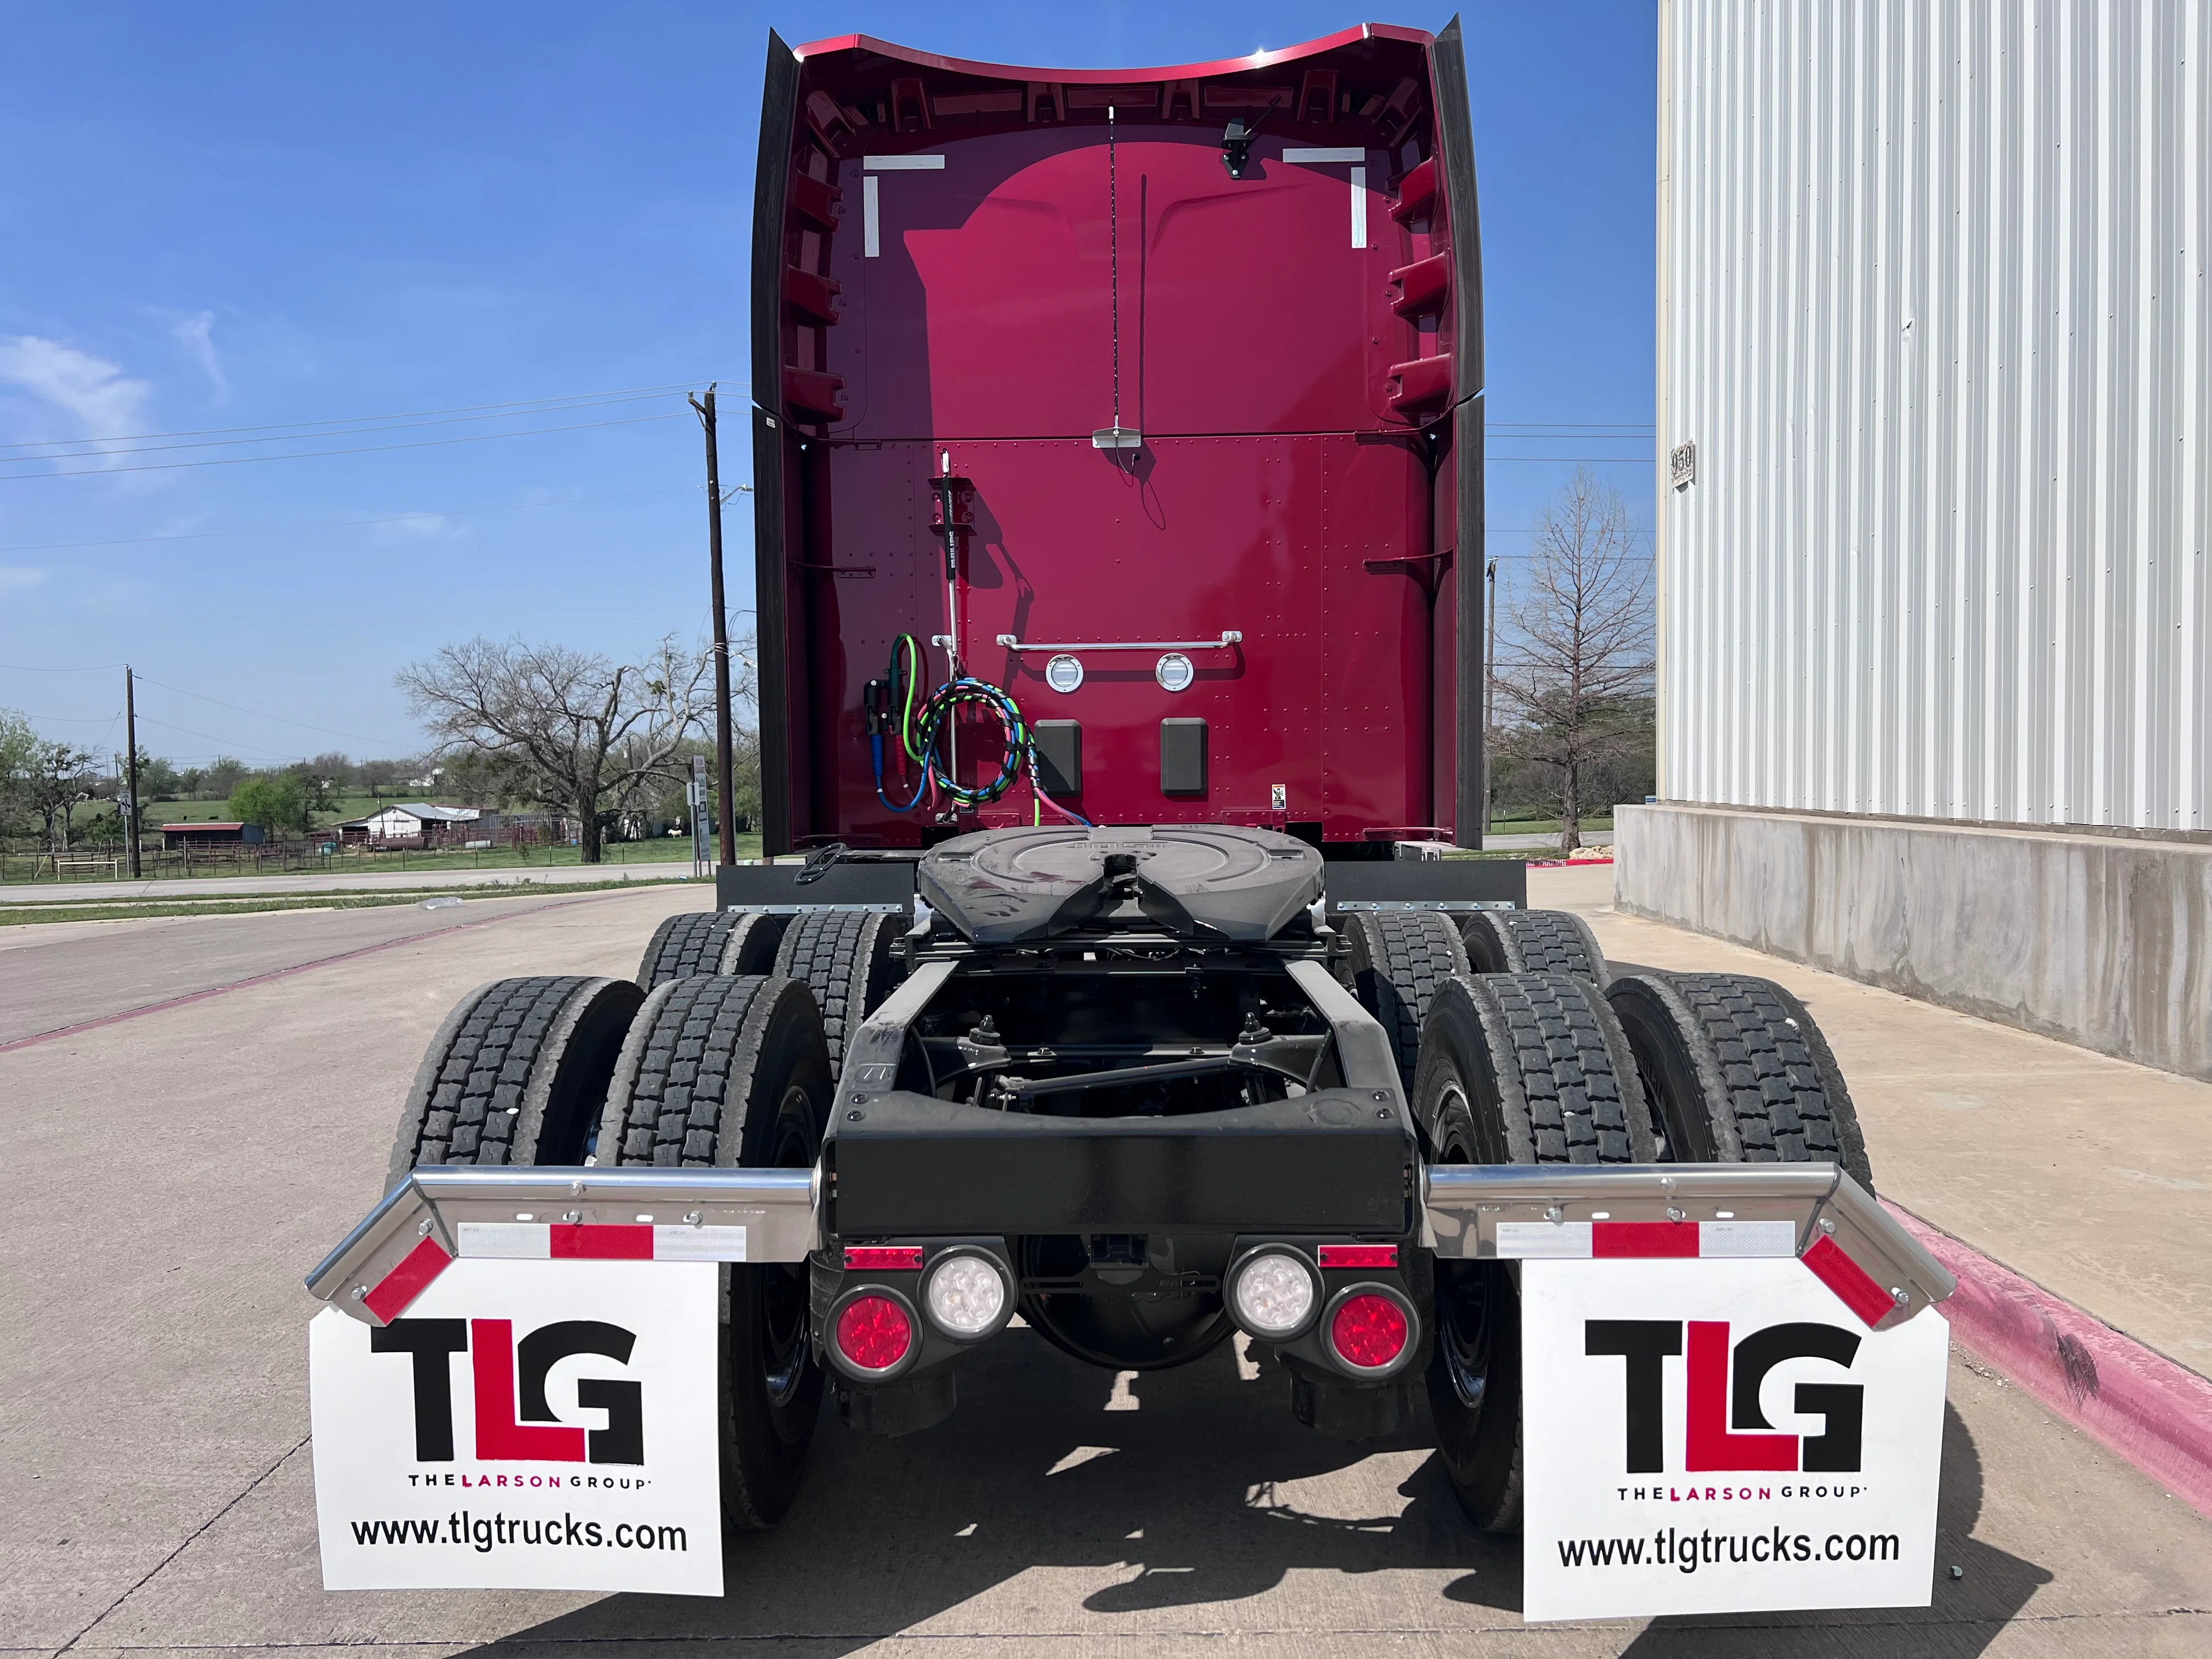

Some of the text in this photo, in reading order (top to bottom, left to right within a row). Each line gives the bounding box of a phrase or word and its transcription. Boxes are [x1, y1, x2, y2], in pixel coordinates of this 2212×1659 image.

[370, 1318, 645, 1466] TLG
[1584, 1318, 1864, 1474] TLG
[569, 1476, 645, 1489] GROUP
[1781, 1486, 1861, 1498] GROUP
[351, 1510, 687, 1553] www.tlgtrucks.com
[1557, 1526, 1900, 1574] www.tlgtrucks.com
